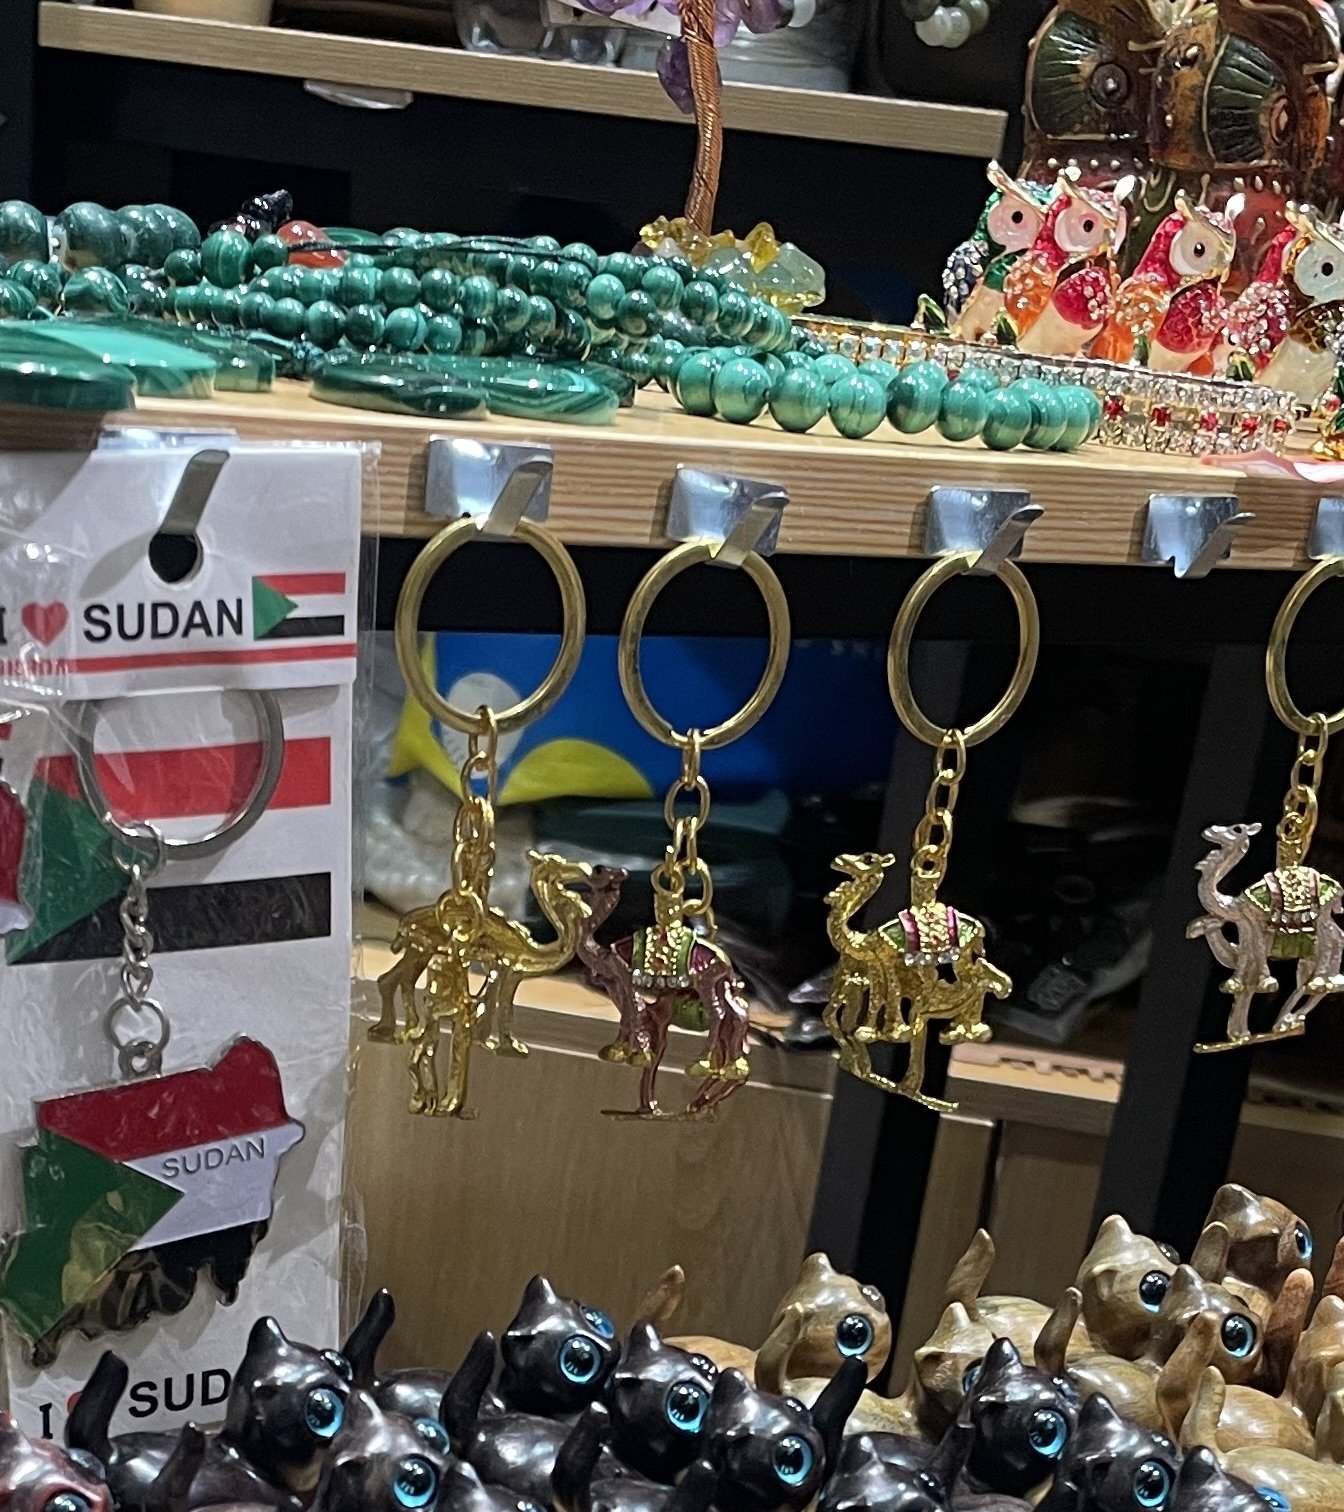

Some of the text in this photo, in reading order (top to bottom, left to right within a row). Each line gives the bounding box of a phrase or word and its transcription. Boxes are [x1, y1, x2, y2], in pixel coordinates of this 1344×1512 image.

[83, 598, 243, 642] SUDAN
[161, 1137, 266, 1180] SUDAN
[38, 1368, 233, 1440] I SUD
